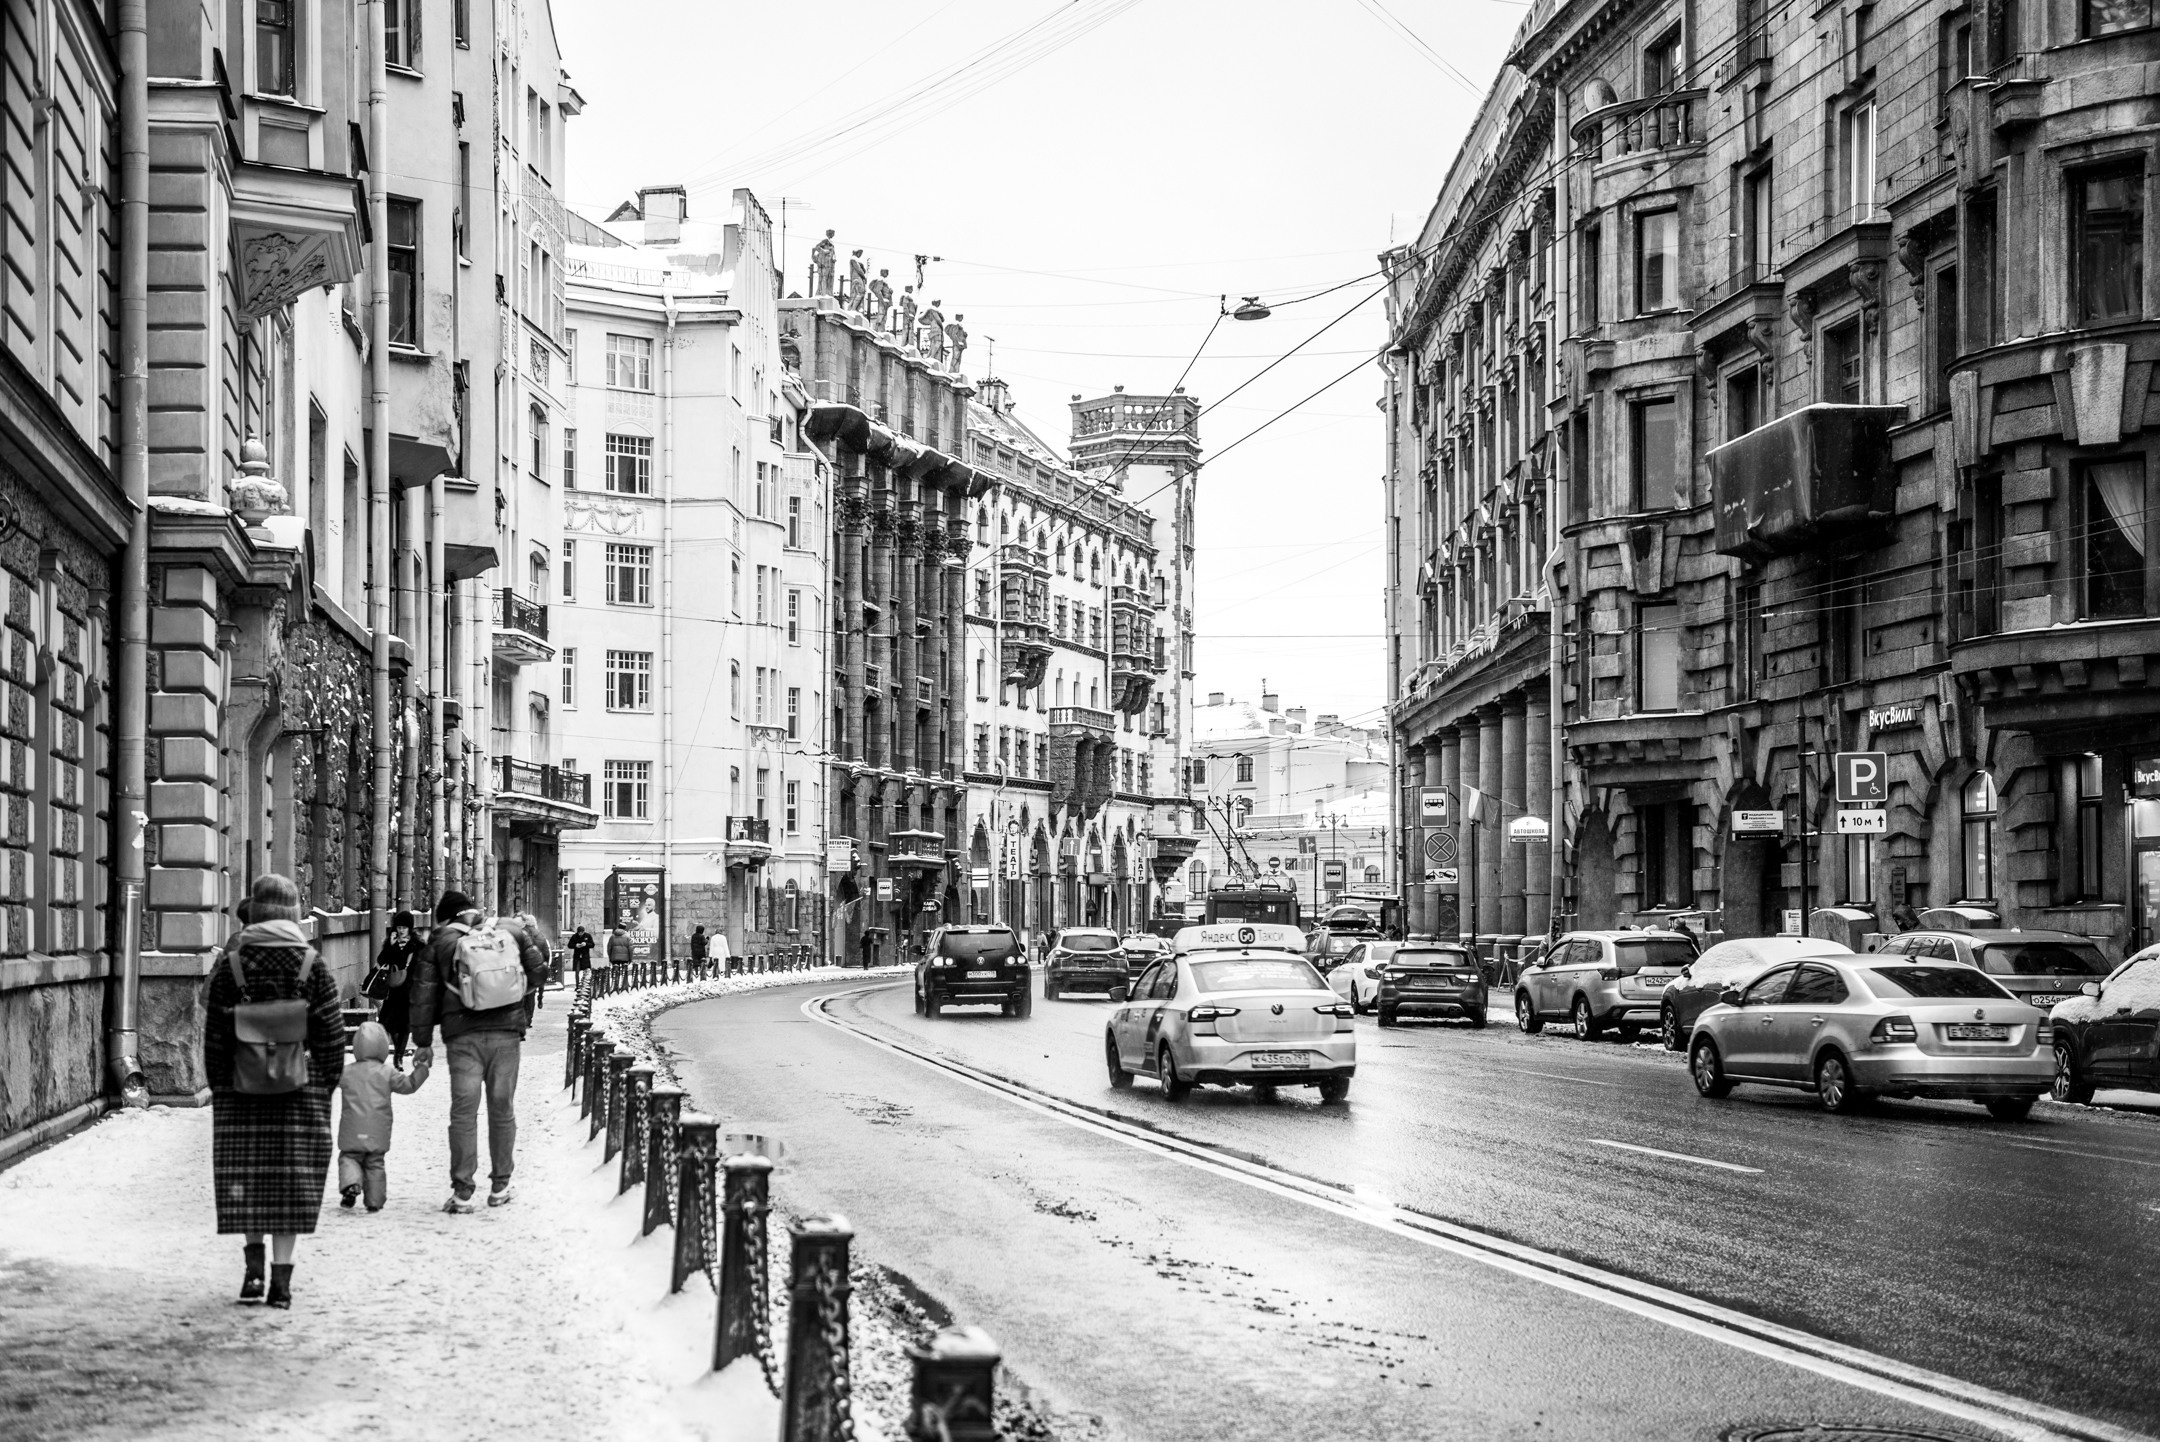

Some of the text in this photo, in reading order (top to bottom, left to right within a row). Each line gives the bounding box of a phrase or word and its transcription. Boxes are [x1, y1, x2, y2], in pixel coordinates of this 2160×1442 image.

[1870, 707, 1912, 730] ВкусВилл
[1851, 759, 1877, 796] P
[1853, 817, 1863, 826] 10
[1267, 905, 1276, 913] 31
[1201, 929, 1285, 943] Яндекс Go Такси
